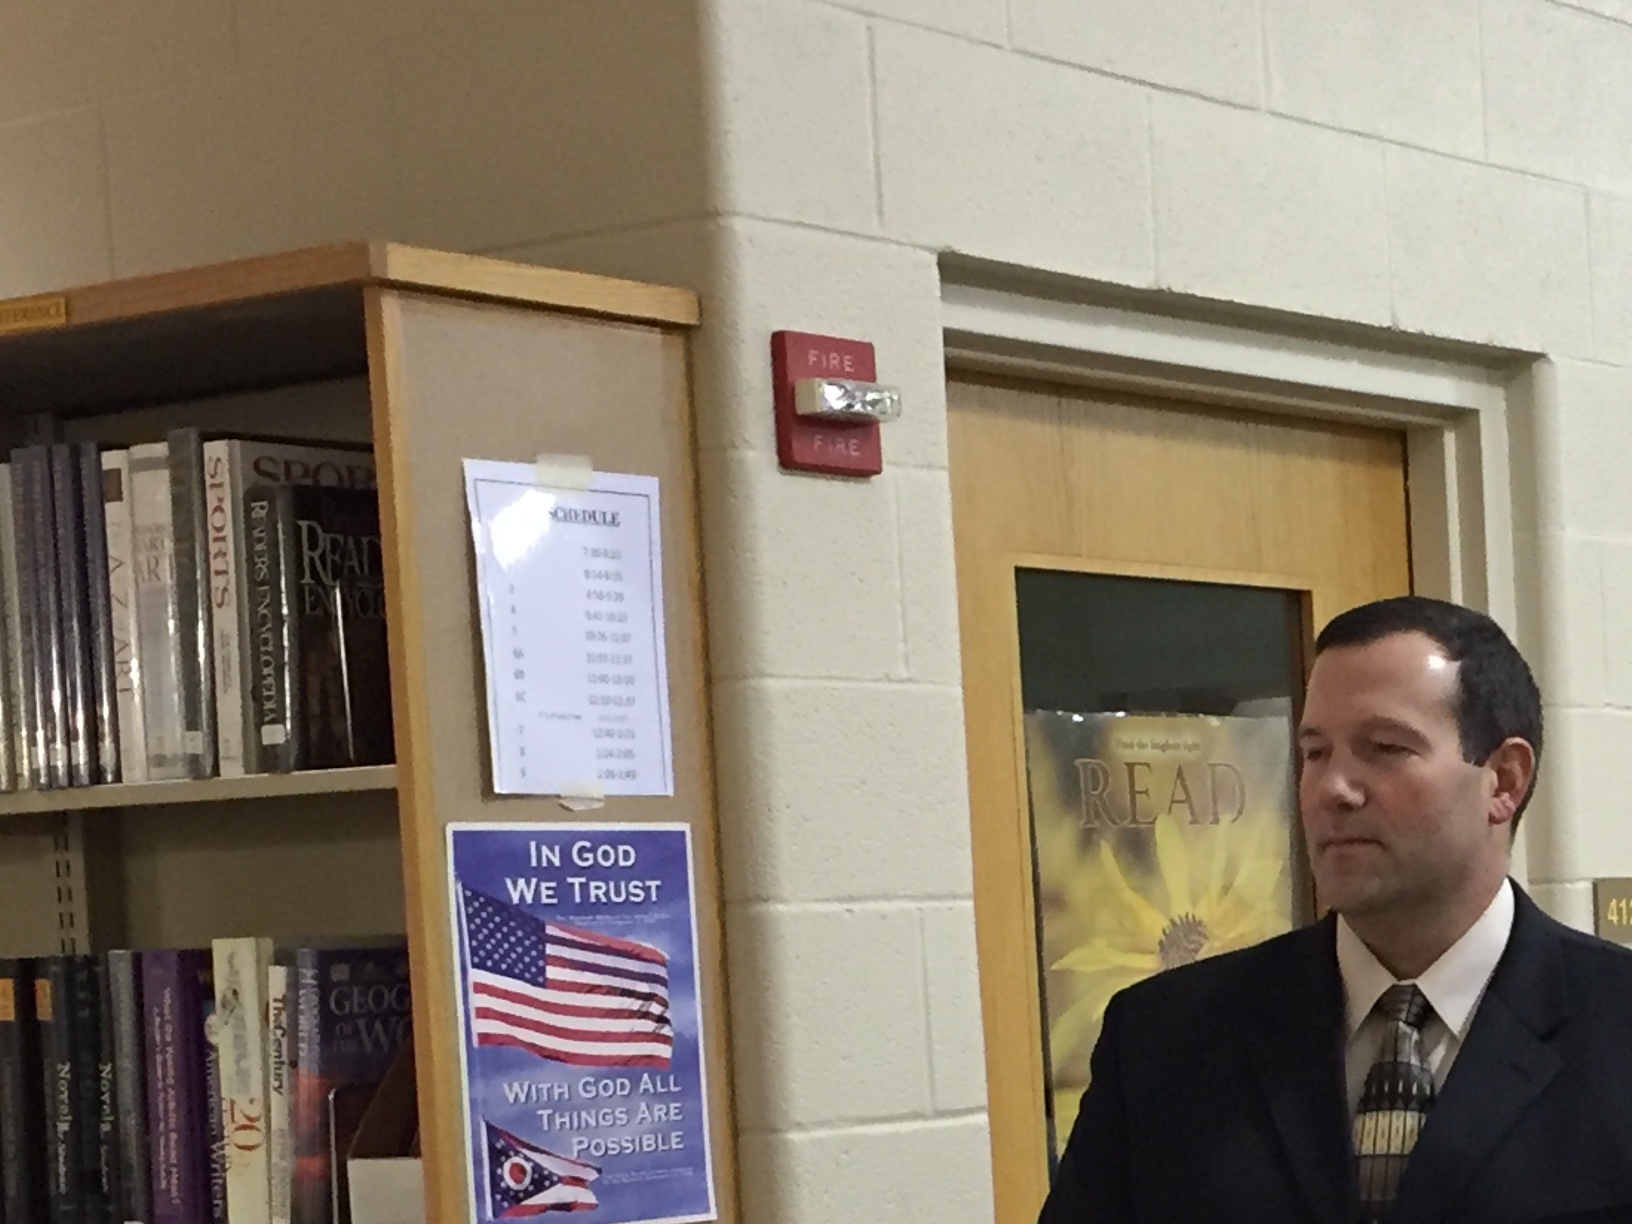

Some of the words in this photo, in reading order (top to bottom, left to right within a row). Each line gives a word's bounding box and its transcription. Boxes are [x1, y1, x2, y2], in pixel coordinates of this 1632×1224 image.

[807, 349, 855, 373] FIRE
[812, 434, 861, 457] FIRE
[206, 455, 236, 610] SPORTS
[1074, 757, 1247, 830] READ
[529, 840, 561, 868] IN
[572, 839, 637, 868] GOD
[505, 877, 558, 905] WE
[567, 876, 663, 904] TRUST
[271, 1024, 286, 1097] Century
[56, 1061, 72, 1130] Novels
[503, 1078, 570, 1105] WITH
[578, 1076, 631, 1099] GOD
[638, 1073, 683, 1095] ALL
[536, 1107, 629, 1132] THINGS
[635, 1101, 684, 1124] ARE
[572, 1130, 685, 1159] POSSIBLE
[209, 1142, 229, 1219] Writers
